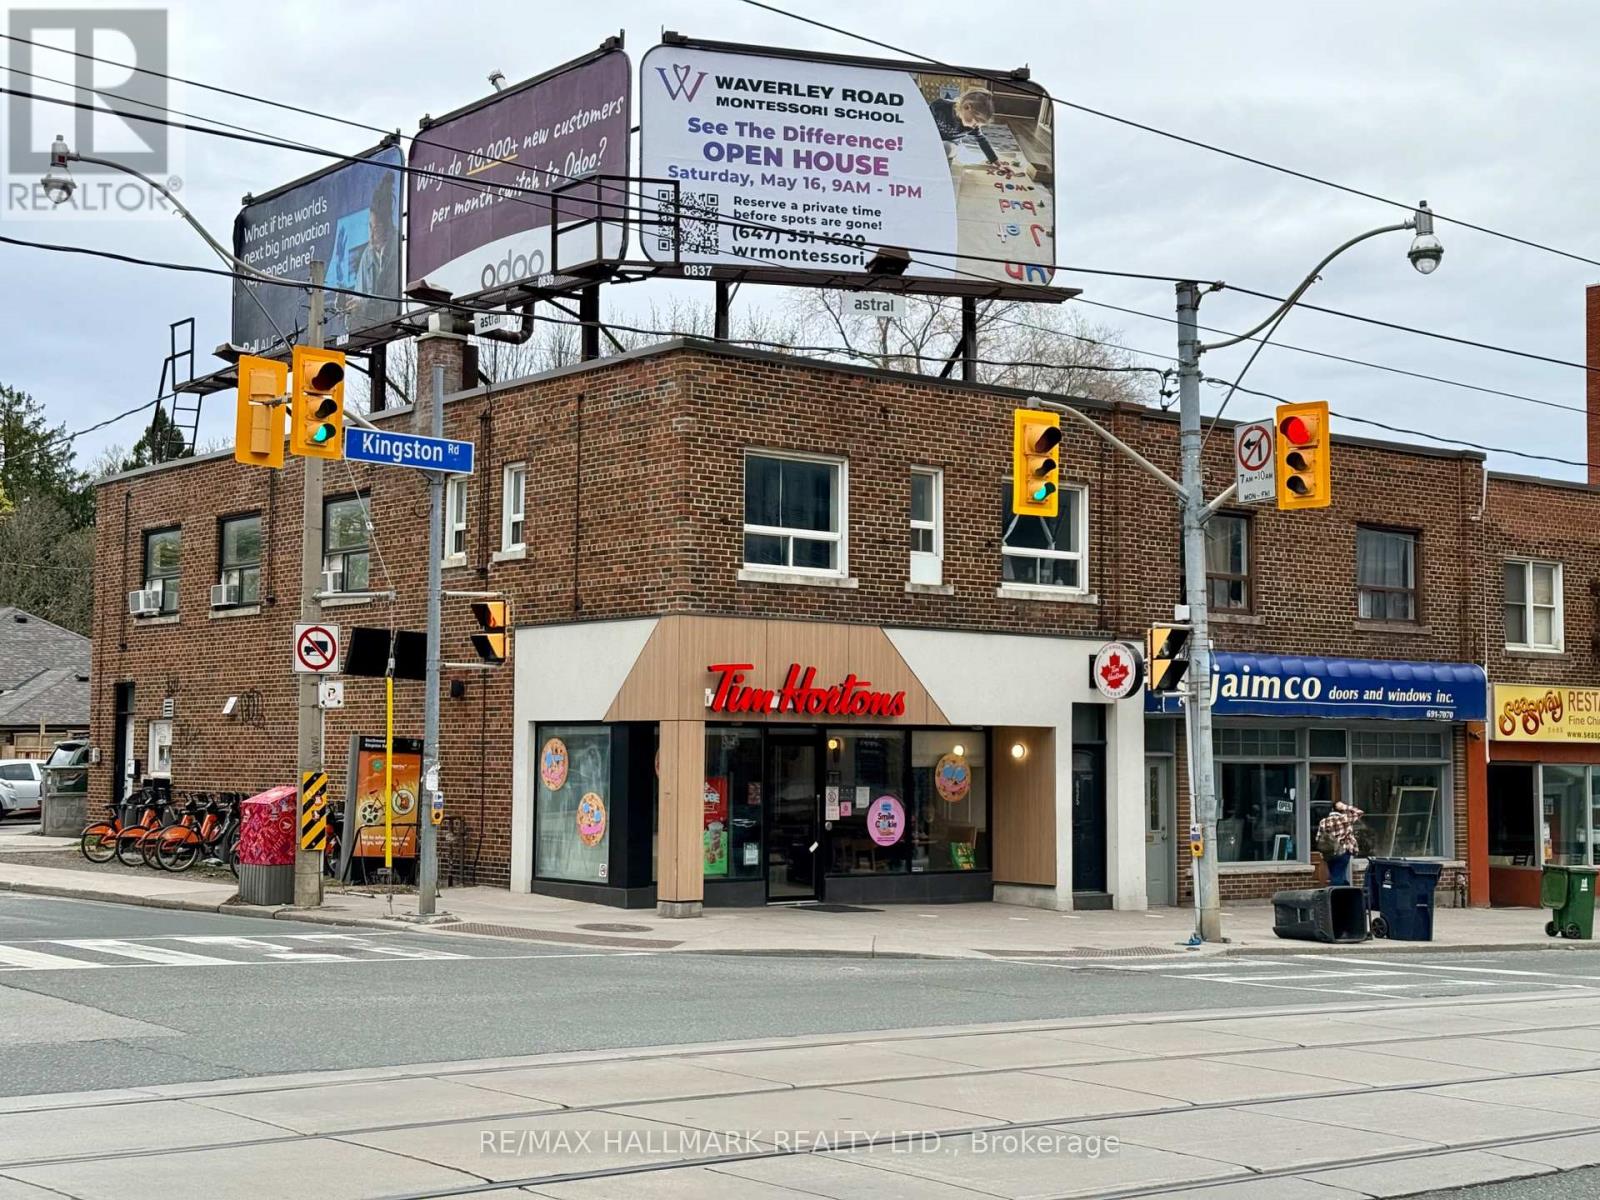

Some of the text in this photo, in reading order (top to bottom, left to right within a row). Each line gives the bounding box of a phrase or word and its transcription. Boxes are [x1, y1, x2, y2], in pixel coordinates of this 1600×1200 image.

[714, 75, 904, 107] WAVERLEY ROAD
[715, 96, 904, 124] MONTESSORI SCHOOL
[416, 95, 625, 192] Why do 10,000+ new customers
[687, 117, 903, 151] See The Difference!
[702, 141, 890, 177] OPEN HOUSE
[430, 136, 608, 232] per month switch to Odoo?
[667, 164, 755, 188] Saturday,
[760, 172, 797, 191] May
[803, 176, 826, 192] 16,
[832, 179, 871, 194] 9AM
[888, 184, 922, 198] 1PM
[733, 196, 882, 217] Reserve a private time
[733, 209, 882, 232] before spots are gone!
[243, 220, 268, 243] What
[270, 215, 277, 233] if
[278, 211, 293, 230] the
[732, 226, 781, 245] (647)
[243, 222, 330, 265] next big innovation
[481, 249, 544, 290] odoo
[683, 264, 713, 277] 0837
[853, 298, 894, 312] astral
[361, 433, 460, 463] Kingston Rd
[707, 663, 906, 716] Tim Hortons
[1209, 664, 1454, 707] jaimco doors and windows inc.
[1568, 691, 1600, 712] REST
